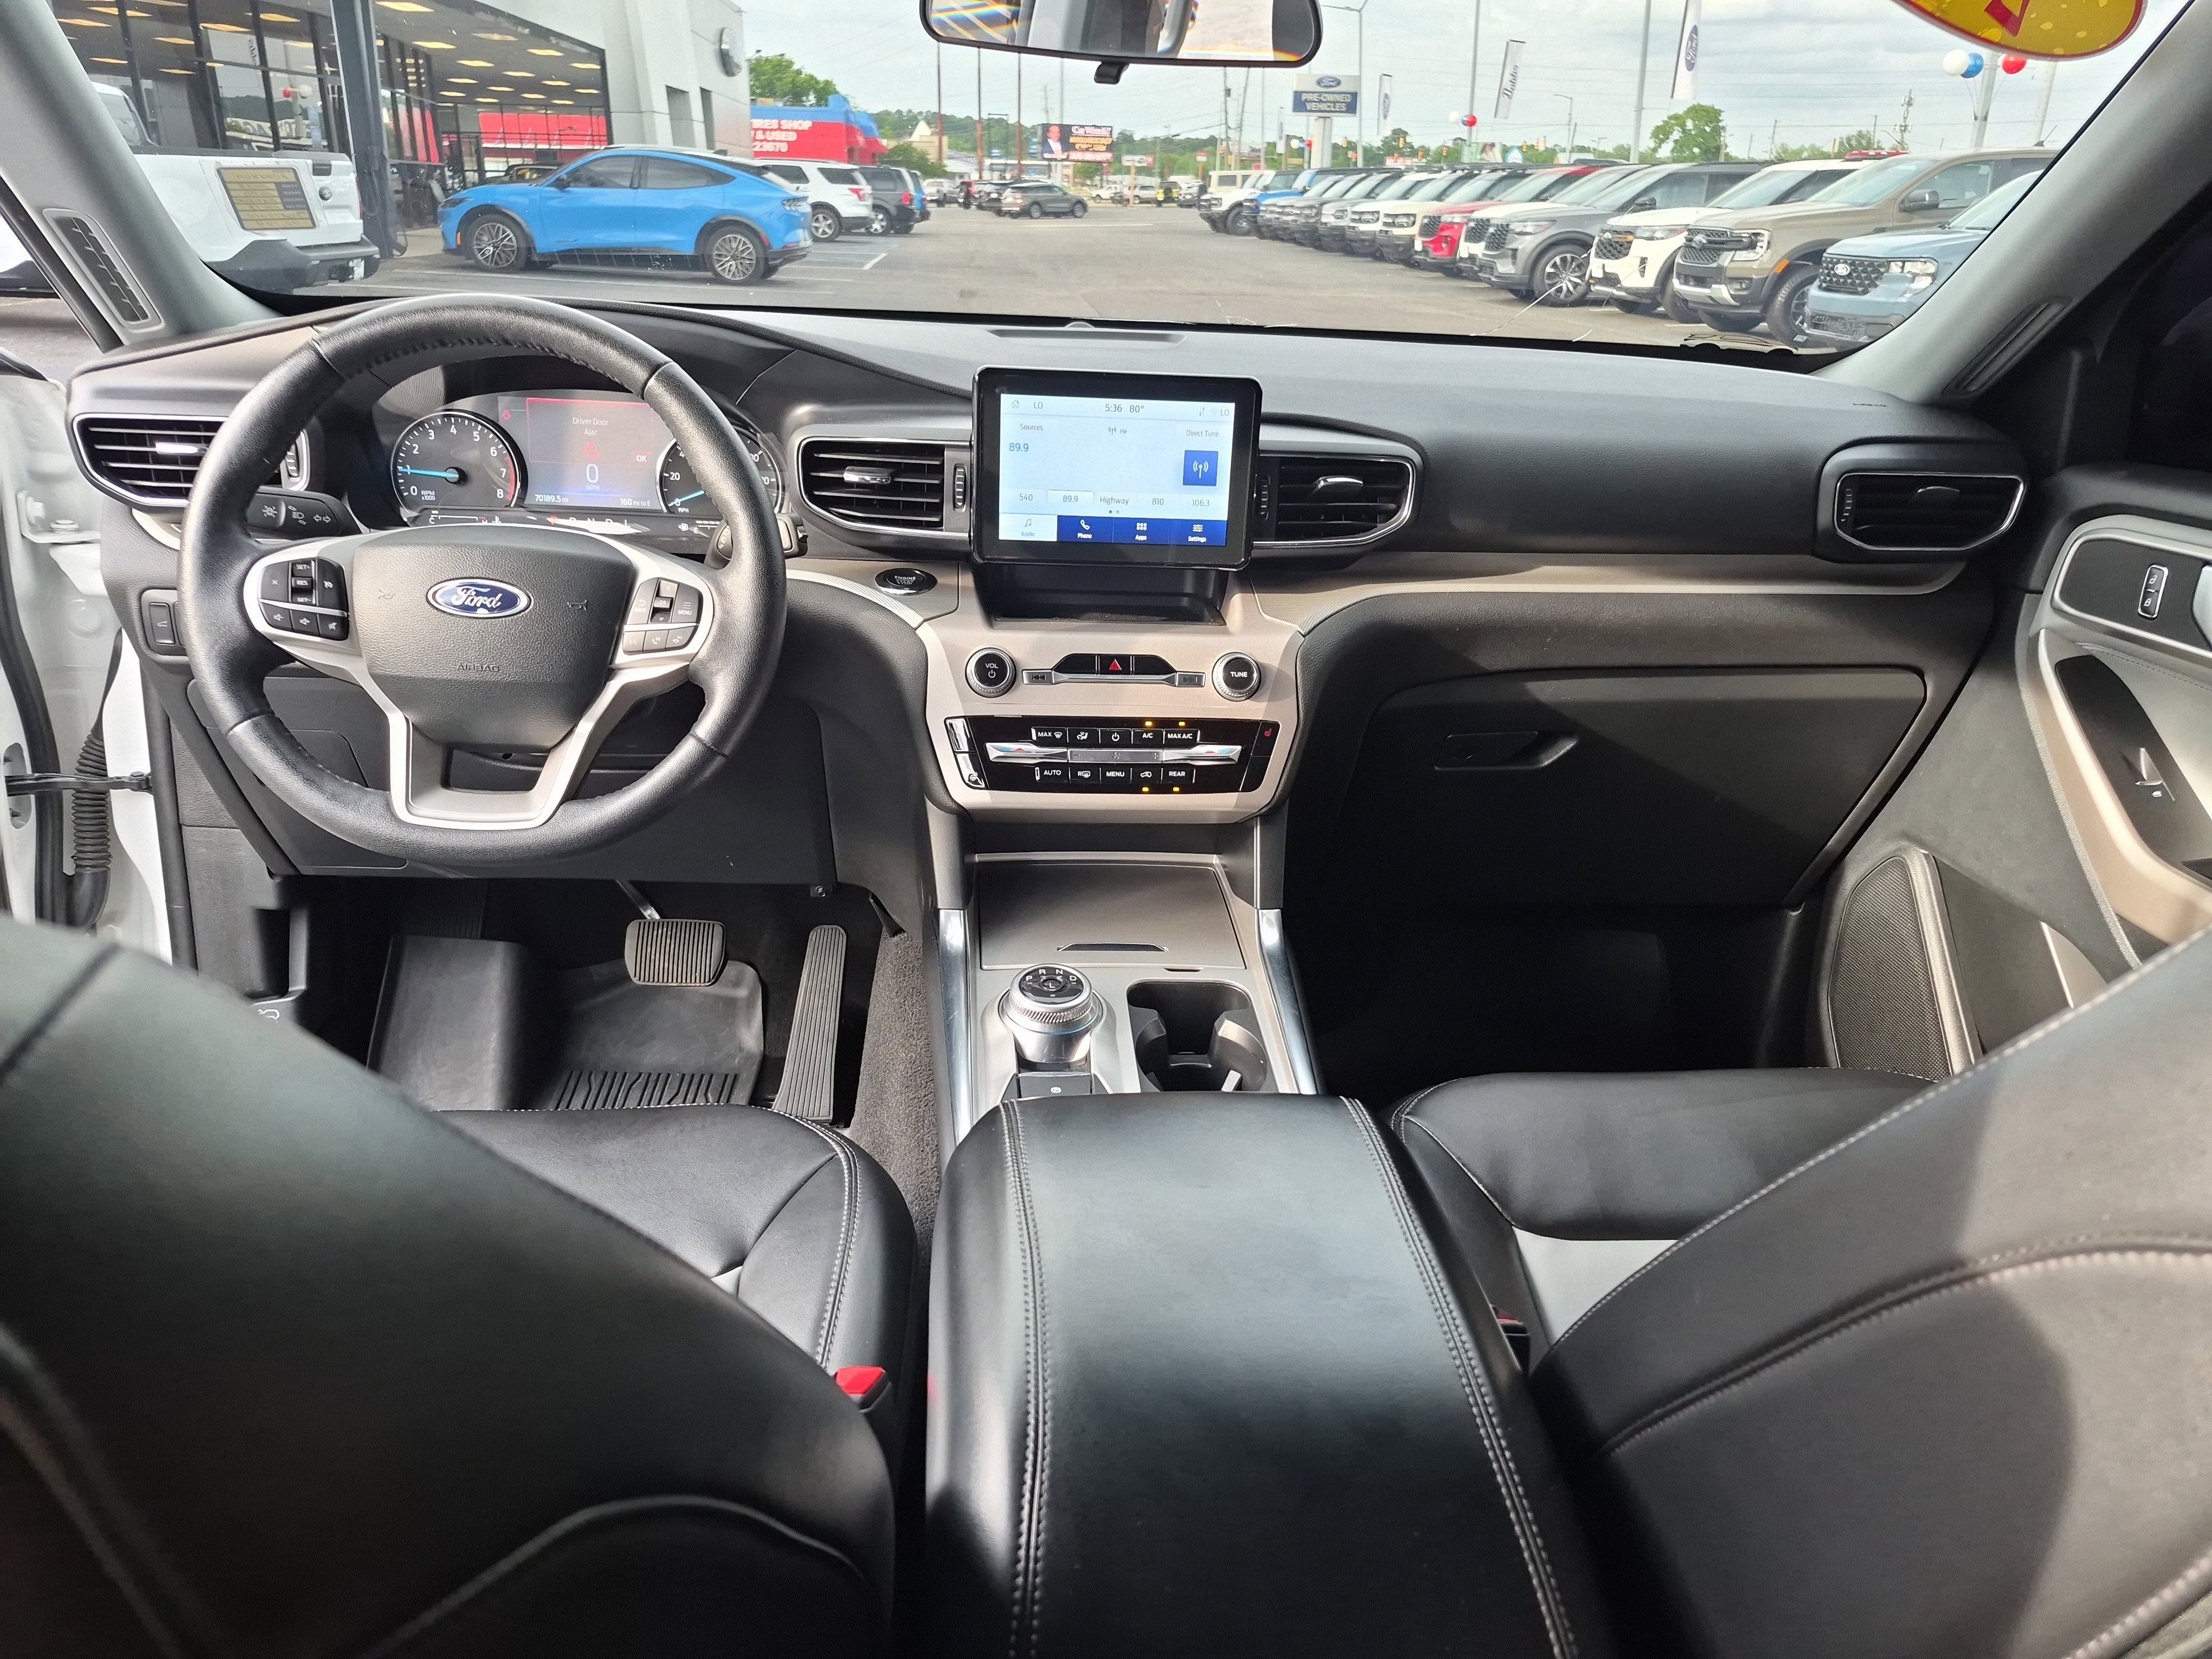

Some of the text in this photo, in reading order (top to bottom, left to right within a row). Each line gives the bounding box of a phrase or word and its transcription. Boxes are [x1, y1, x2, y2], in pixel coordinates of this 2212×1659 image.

[1301, 93, 1352, 102] PRE-OWNED
[1306, 102, 1347, 111] VEHICLES
[779, 120, 813, 130] SHOP
[764, 131, 798, 141] USED
[1105, 404, 1144, 413] 5:36 80°
[450, 425, 457, 434] 4
[584, 428, 598, 436] Ajar
[428, 430, 435, 440] 3
[473, 432, 480, 441] 5
[413, 444, 419, 454] 2
[490, 447, 497, 456] 6
[1009, 442, 1029, 452] 89.9
[750, 453, 760, 462] 00
[500, 468, 506, 478] 7
[586, 464, 599, 484] 0
[670, 472, 680, 480] 20
[410, 486, 417, 496] 0
[497, 489, 504, 499] 8
[535, 494, 562, 503] 70189.5
[1063, 495, 1078, 503] 89.9
[1100, 496, 1129, 506] Highway
[451, 586, 503, 608] Ford
[456, 663, 500, 672] AIRBAG
